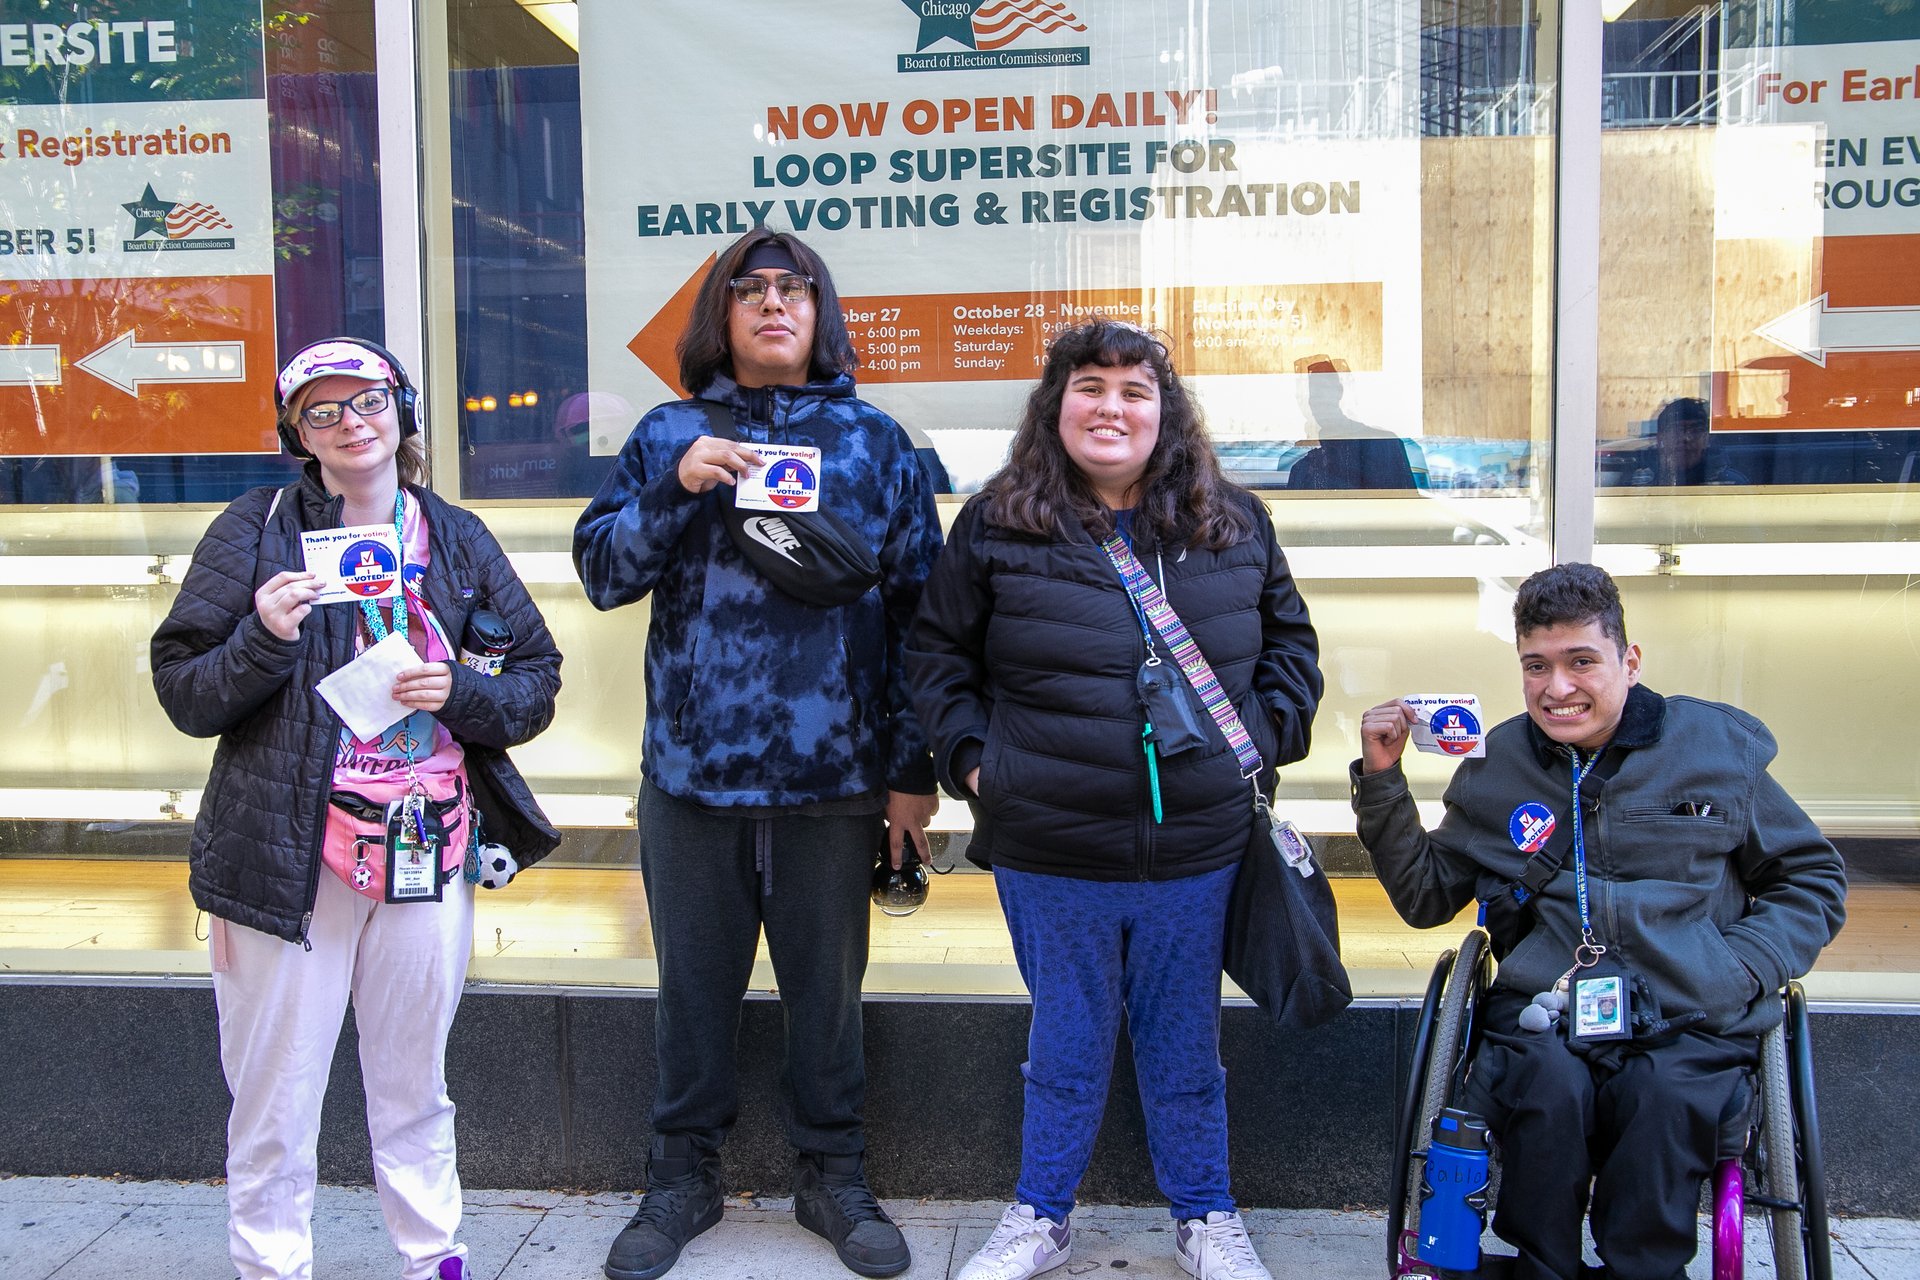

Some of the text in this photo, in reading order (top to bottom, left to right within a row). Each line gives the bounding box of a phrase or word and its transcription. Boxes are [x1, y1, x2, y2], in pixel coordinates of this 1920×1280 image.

[921, 0, 970, 19] Chicago
[904, 51, 1082, 69] Board of Election Commissioners
[1758, 73, 1827, 105] For
[767, 89, 1218, 140] NOW OPEN DAILY!
[17, 124, 232, 166] Registration
[753, 138, 1238, 188] LOOP SUPERSITE FOR
[135, 207, 165, 219] Chicago
[637, 180, 1361, 237] EARLY VOTING & REGISTRATION
[66, 228, 96, 254] 5!
[127, 242, 147, 251] Board
[148, 241, 155, 250] of
[182, 239, 231, 249] Commissioners
[880, 307, 901, 322] 27
[953, 305, 1020, 320] October
[1024, 303, 1045, 318] 28
[867, 327, 896, 339] 6:00
[900, 329, 920, 340] pm
[953, 324, 1024, 337] Weekdays:
[953, 340, 1014, 354] Saturday:
[1193, 336, 1223, 348] 6:00
[1226, 337, 1247, 347] am
[868, 343, 896, 355] 5:00
[900, 345, 921, 356] pm
[868, 359, 897, 371] 4:00
[900, 361, 921, 372] pm
[954, 356, 1005, 370] Sunday:
[764, 449, 777, 457] you
[790, 451, 816, 460] voting!
[305, 535, 330, 544] Thank
[332, 534, 347, 543] you
[362, 530, 390, 538] voting!
[759, 517, 802, 552] NIKE
[354, 573, 385, 582] VOTED!
[1450, 698, 1475, 706] voting!
[1526, 823, 1549, 843] VOTED!
[1428, 1160, 1482, 1184] Pablo
